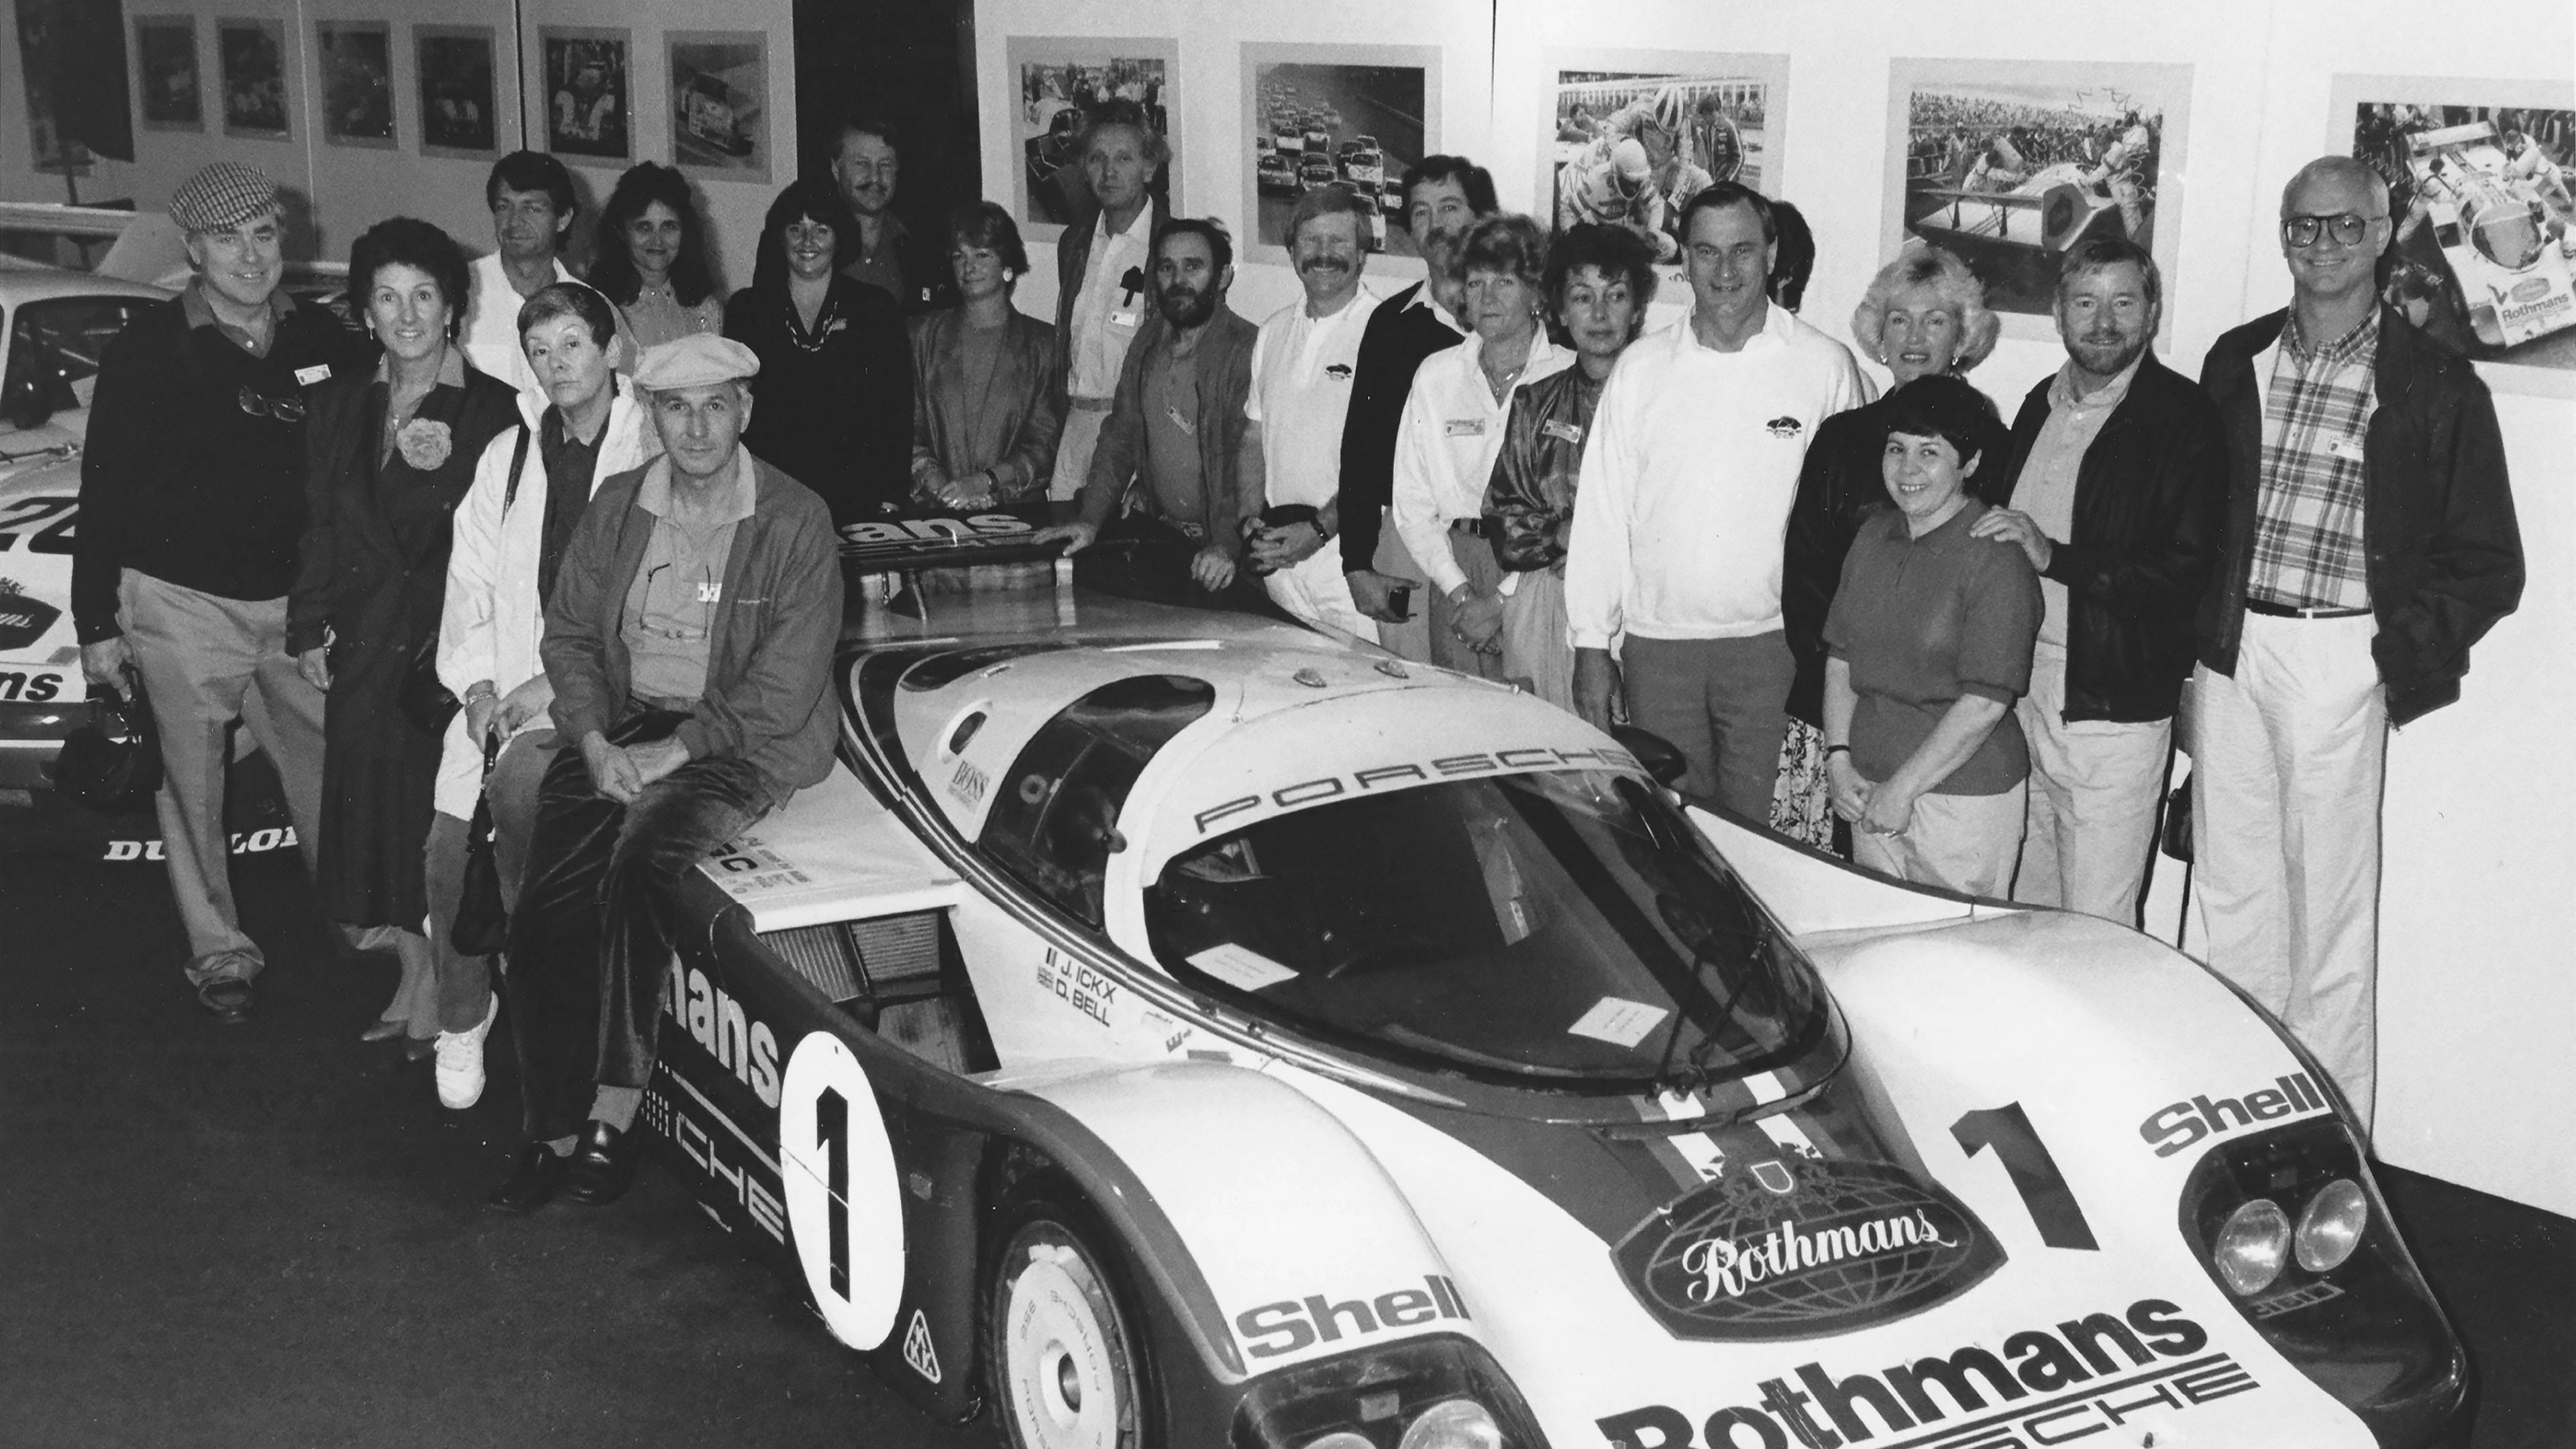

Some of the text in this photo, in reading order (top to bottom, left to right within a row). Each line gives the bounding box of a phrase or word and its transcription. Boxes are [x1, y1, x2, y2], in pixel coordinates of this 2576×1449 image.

[2501, 292, 2569, 322] Rothmans
[952, 759, 990, 802] BOSS
[1194, 747, 1642, 834] PORSCHE
[1072, 988, 1110, 1028] BELL
[1075, 966, 1116, 1004] ICKX
[2139, 1072, 2328, 1158] Shell
[816, 1085, 851, 1304] 1
[1949, 1101, 2100, 1251] 1
[1682, 1208, 1957, 1302] Rothmans
[1235, 1274, 1471, 1359] Shell
[1595, 1299, 2208, 1449] Rothmans
